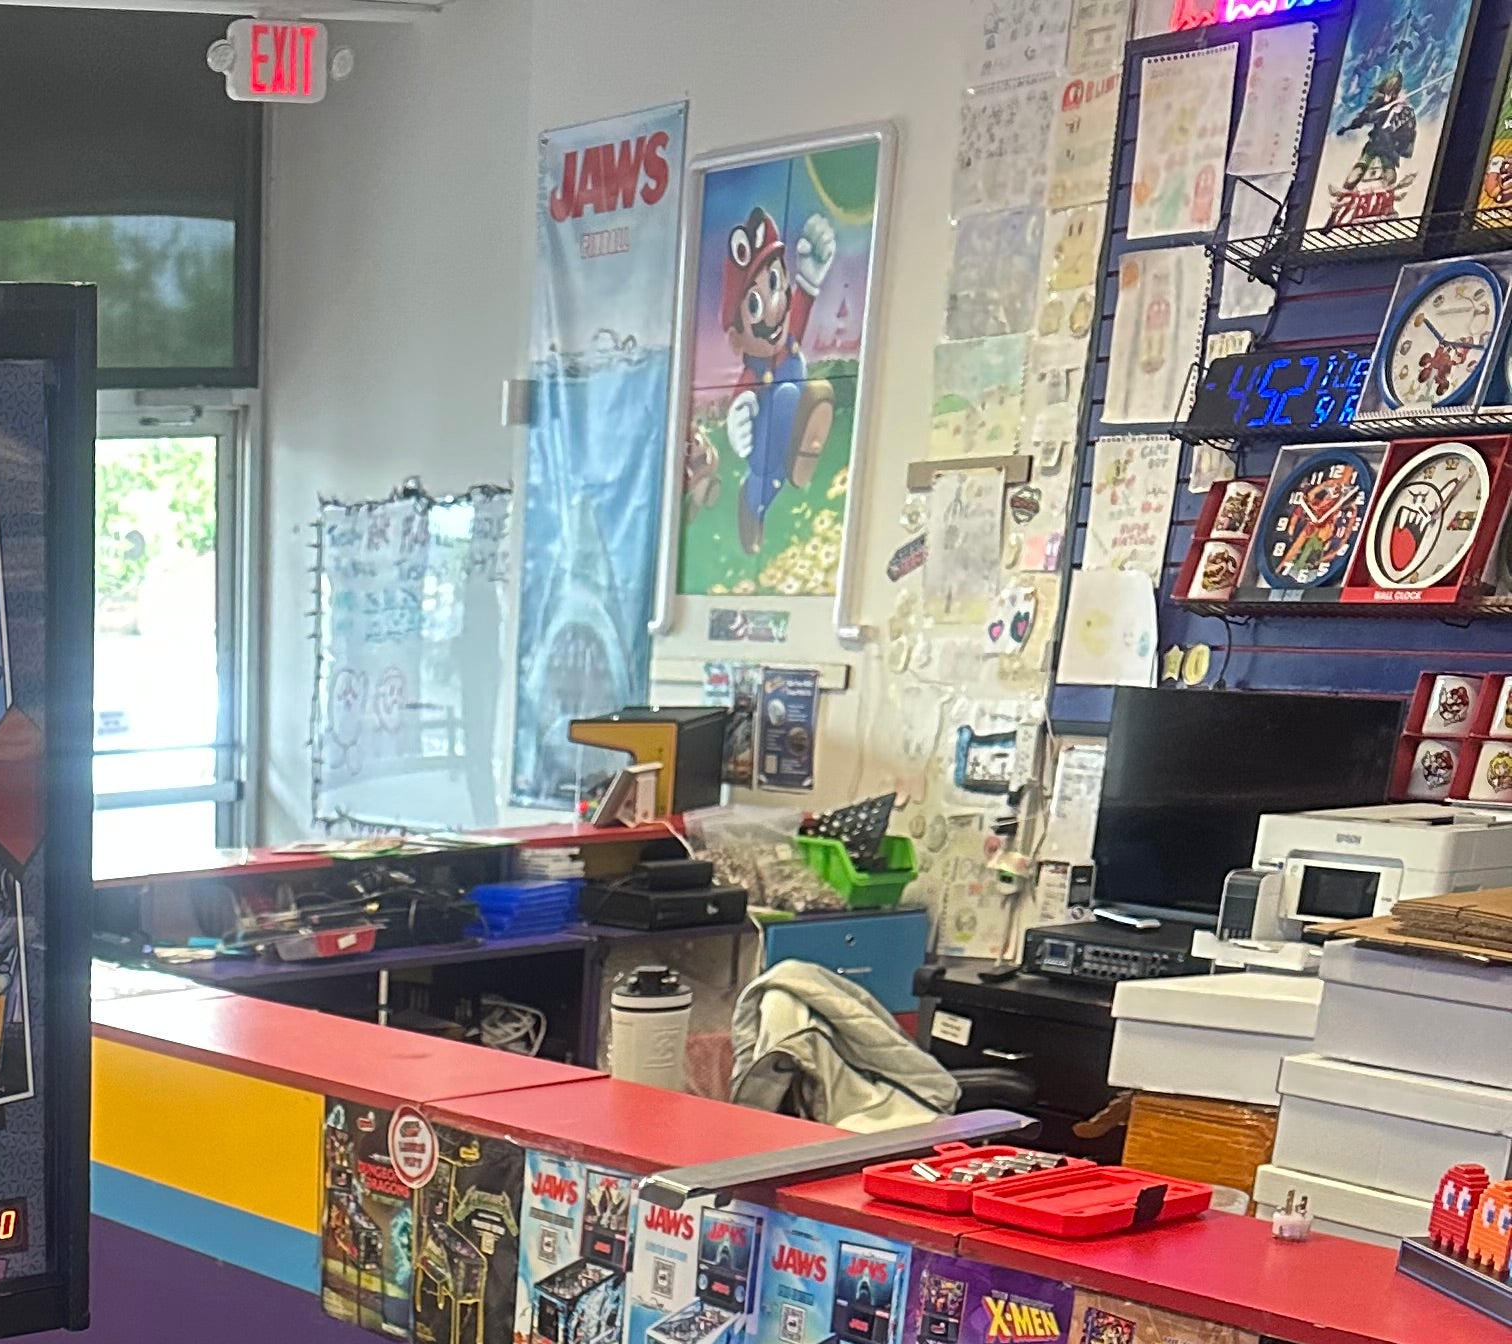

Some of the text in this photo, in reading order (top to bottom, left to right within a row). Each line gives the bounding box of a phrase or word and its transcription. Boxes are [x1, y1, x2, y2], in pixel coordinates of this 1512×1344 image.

[251, 24, 317, 96] EXIT
[549, 131, 669, 223] JAWS
[1310, 471, 1324, 485] 11
[1329, 465, 1345, 478] 12
[1276, 517, 1288, 531] 9
[1273, 542, 1286, 557] 8
[1317, 562, 1330, 577] 5
[531, 1172, 579, 1205] JAWS
[0, 1210, 17, 1241] 0
[644, 1204, 694, 1240] JAWS
[771, 1245, 828, 1283] JAWS
[846, 1256, 888, 1283] JAWS
[981, 1295, 1061, 1343] X-MEN
